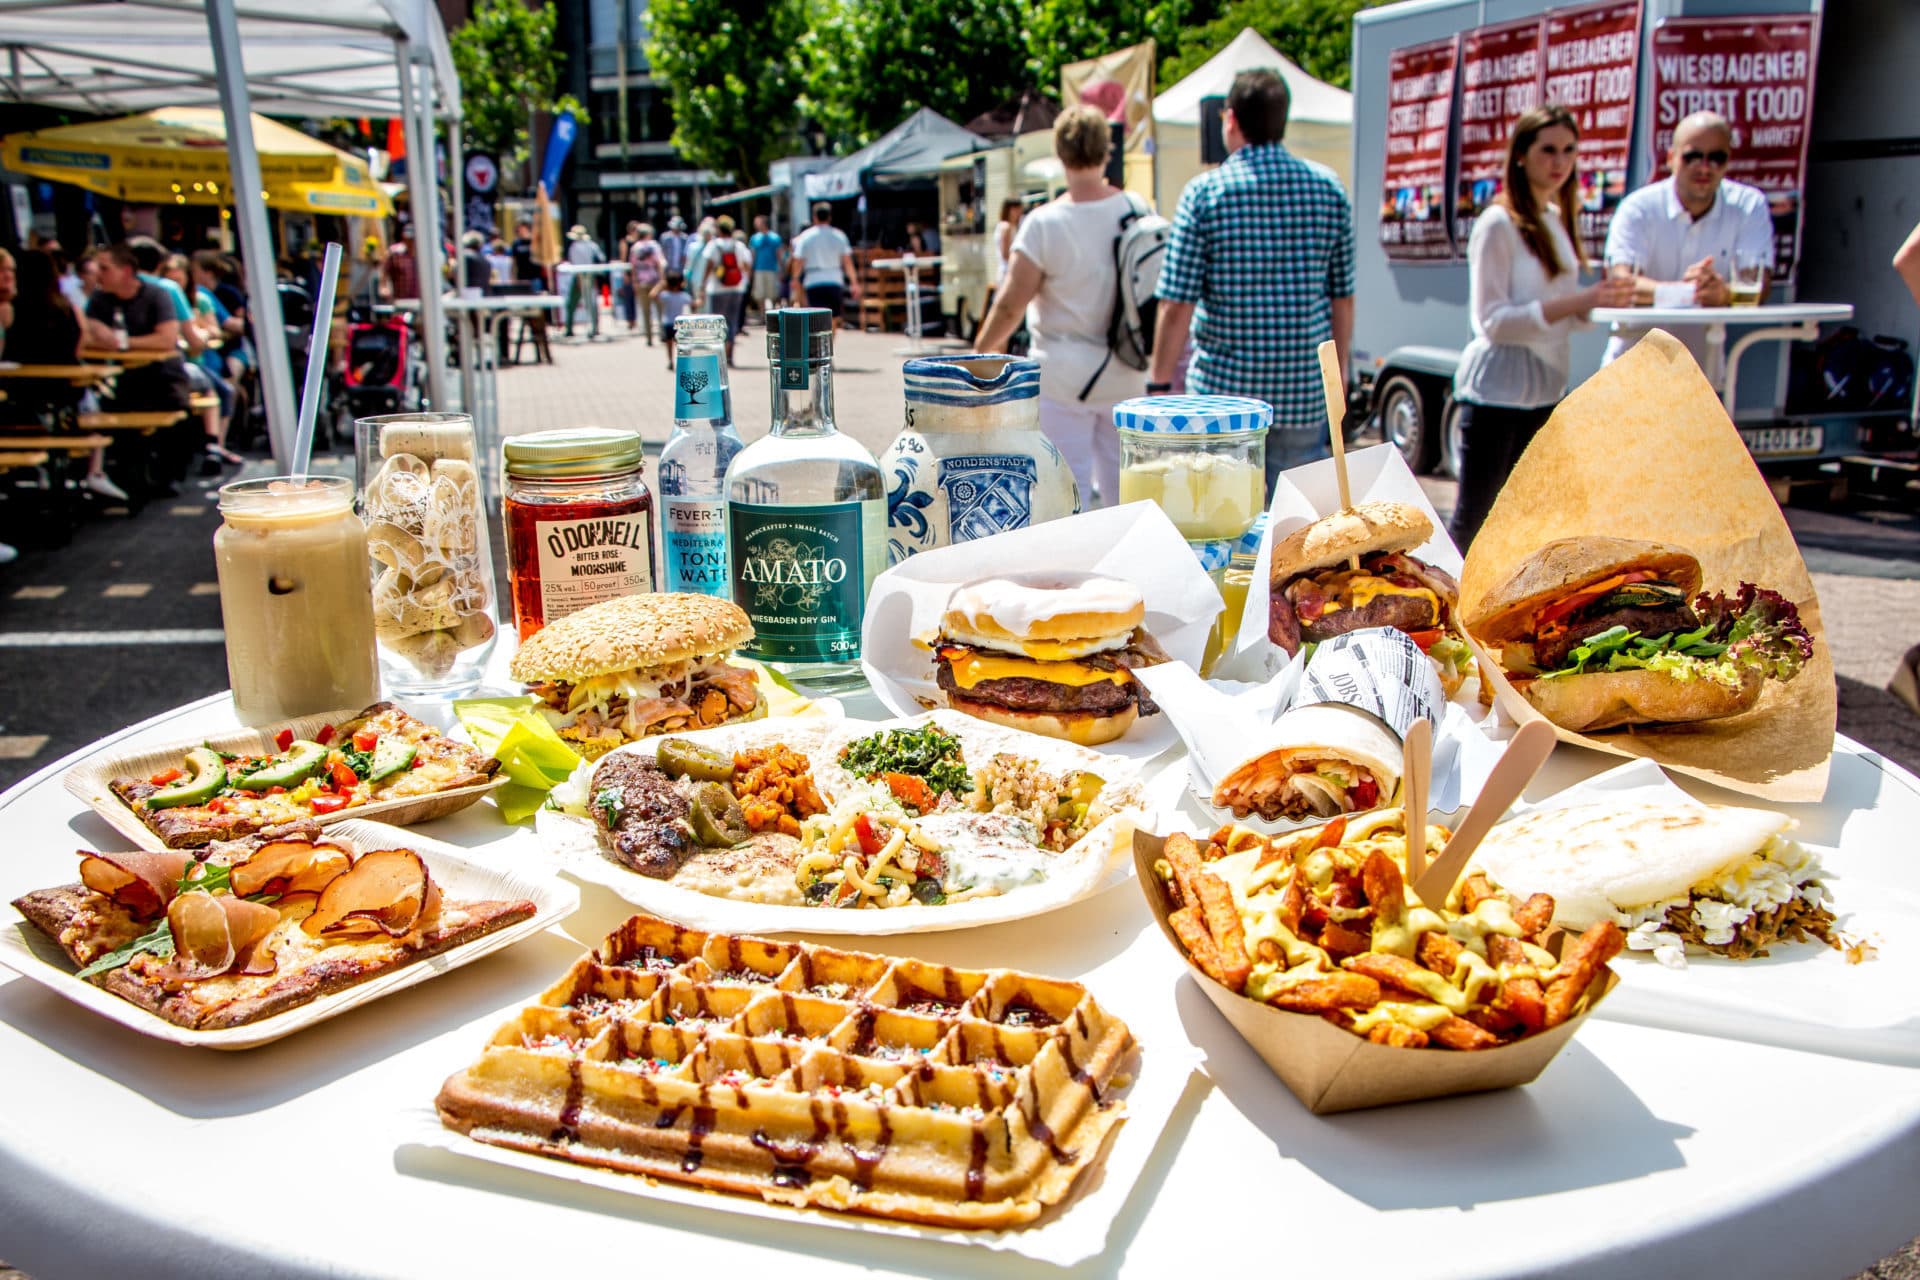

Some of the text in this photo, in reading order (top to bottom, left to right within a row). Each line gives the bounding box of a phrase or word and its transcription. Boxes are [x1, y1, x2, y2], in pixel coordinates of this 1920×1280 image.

[1548, 32, 1634, 70] WIESBADENER
[1656, 52, 1807, 83] WIESBADENER
[1546, 66, 1632, 105] STREET FOOD
[1659, 86, 1805, 123] STREET FOOD
[1751, 126, 1801, 147] MARKET
[946, 457, 1027, 471] NORDENSTADT
[547, 520, 640, 558] O'DONNELL
[745, 523, 840, 544] HANDCRAFTED SMALL BATCH
[576, 549, 619, 562] BITTER ROSE
[571, 560, 627, 577] MOONSHINE
[741, 557, 848, 585] AMATO
[545, 583, 563, 593] 25%
[751, 614, 837, 625] WIESBADEN DRY GIN
[830, 640, 858, 652] 500ml
[1329, 672, 1363, 704] JOBS
